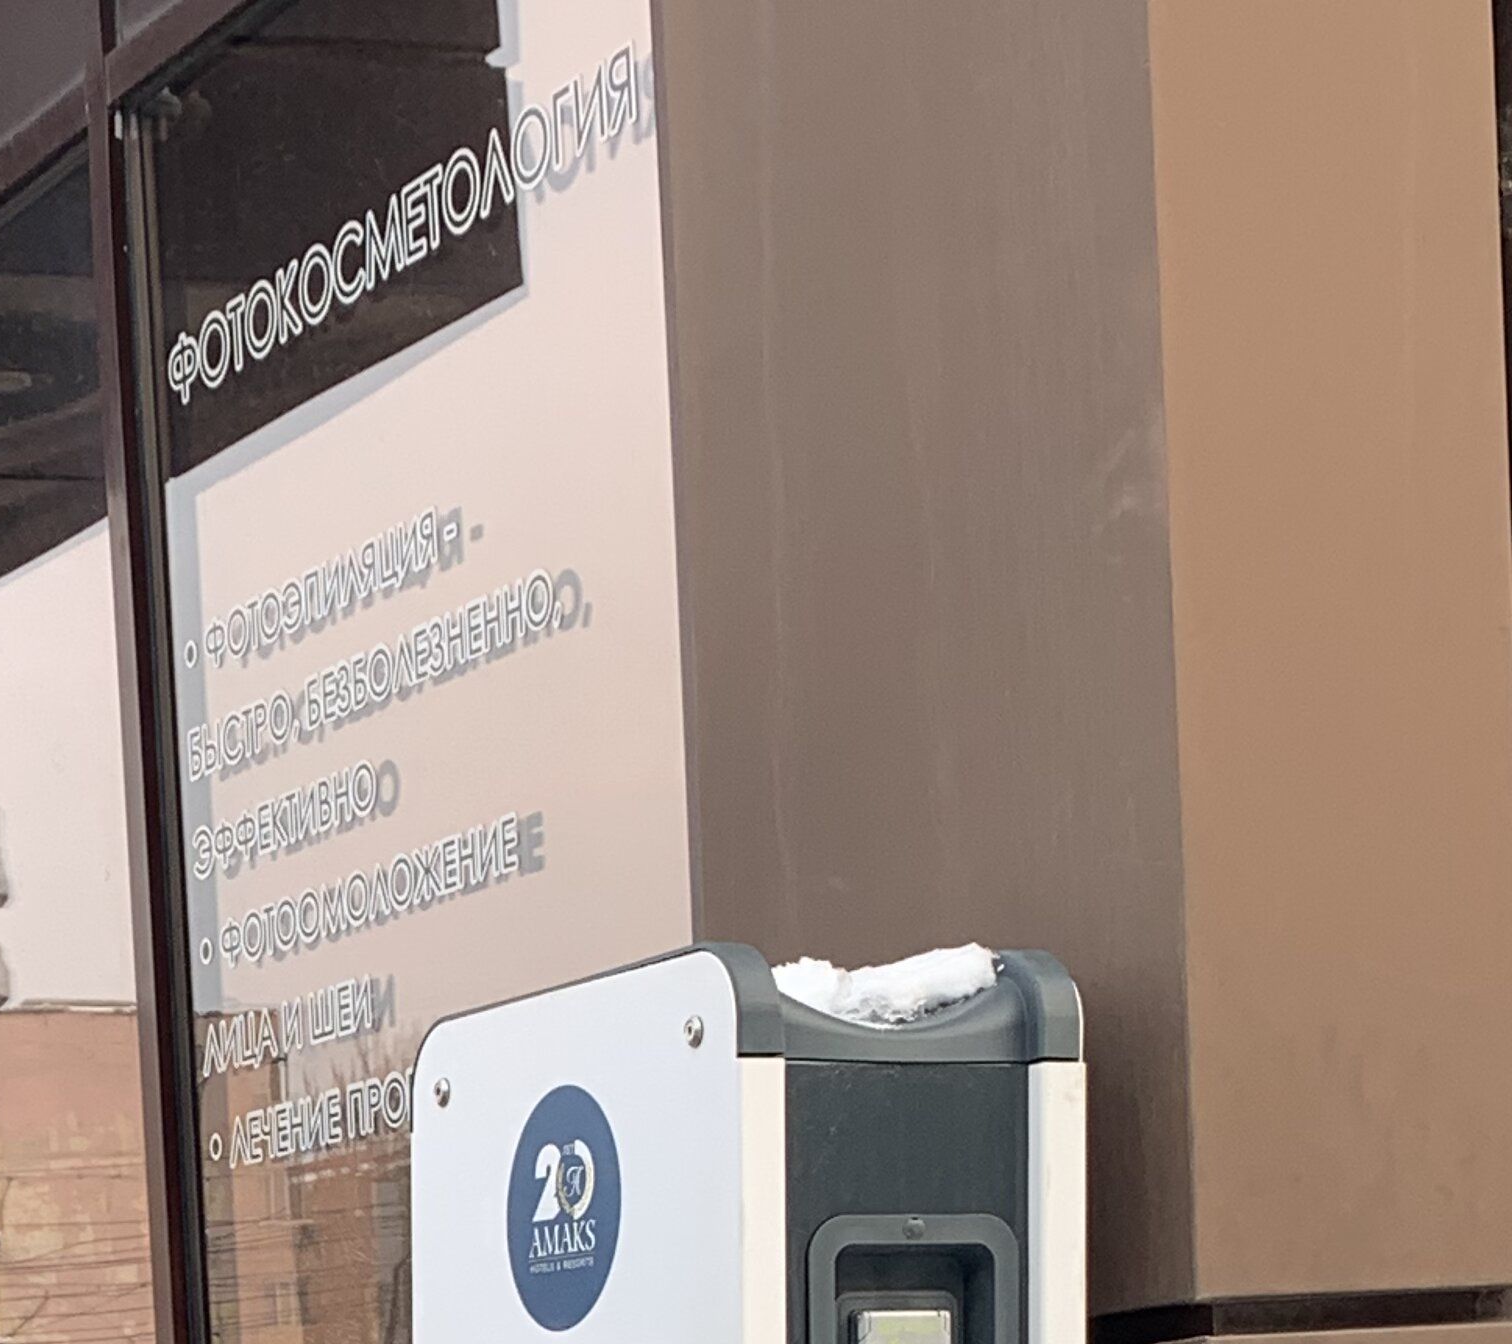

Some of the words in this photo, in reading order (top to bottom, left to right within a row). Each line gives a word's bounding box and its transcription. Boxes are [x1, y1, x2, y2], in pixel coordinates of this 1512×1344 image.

[168, 39, 637, 405] ФОТОКОСМЕТОЛОГИЯ
[205, 505, 438, 668] ФОТОЭПИЛЯЦИЯ
[192, 759, 378, 881] ЭФФЕКТИВНО
[220, 812, 520, 967] ФОТООМОЛОЖЕНИЕ
[202, 1008, 278, 1078] ЛИЦА
[283, 1001, 303, 1054] И
[310, 974, 374, 1043] ШЕИ
[229, 1085, 343, 1170] ЛЕЧЕНИЕ
[532, 1139, 595, 1222] 20
[529, 1219, 596, 1258] AMAKS
